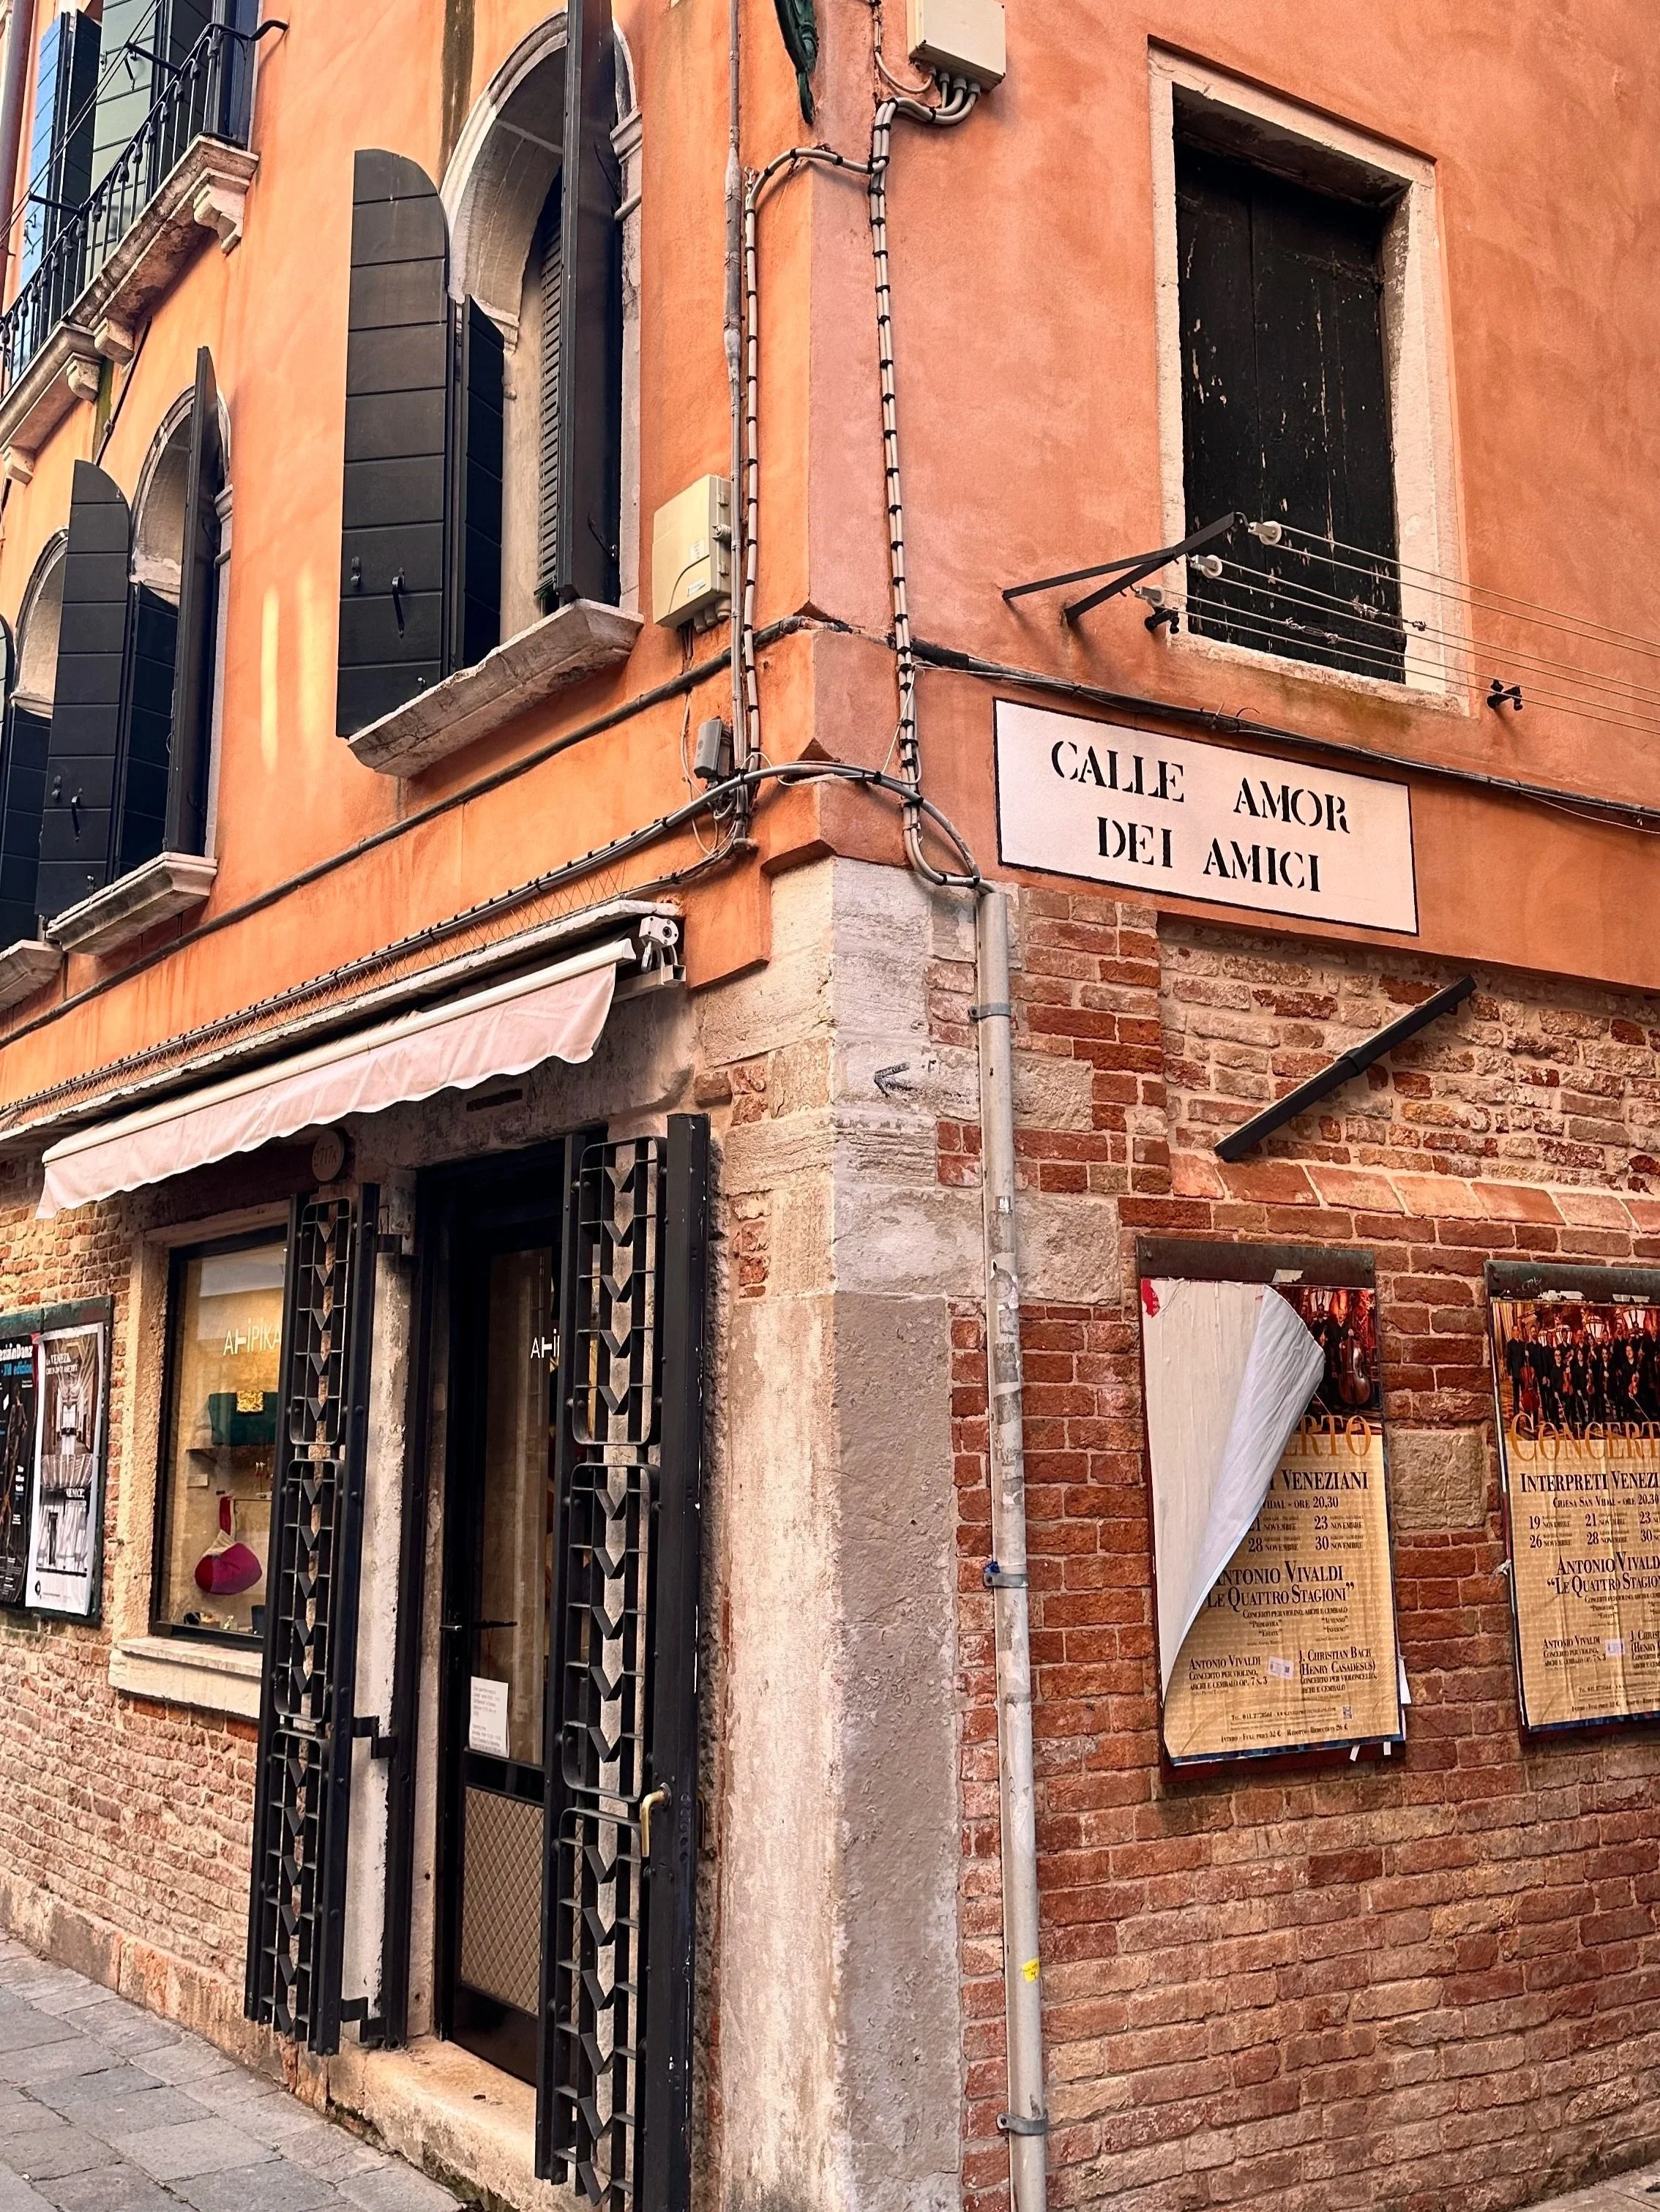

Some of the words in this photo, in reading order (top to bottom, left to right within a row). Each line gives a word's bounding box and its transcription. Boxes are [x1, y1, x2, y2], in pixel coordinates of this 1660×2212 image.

[1051, 740, 1185, 803] CALLE
[1233, 776, 1350, 834] AMOR
[1097, 816, 1173, 869] DEI
[1203, 837, 1321, 893] AMICI
[1510, 1413, 1660, 1462] CONCERT
[1281, 1469, 1369, 1491] VENEZIANI
[1519, 1472, 1609, 1493] INTERPRETI
[1611, 1469, 1659, 1490] VENEZI
[1552, 1496, 1577, 1508] CHIESA
[1579, 1496, 1593, 1507] SAN
[1314, 1515, 1328, 1530] 23
[1528, 1515, 1541, 1530] 19
[1585, 1512, 1597, 1527] 21
[1639, 1510, 1651, 1524] 23
[1315, 1535, 1329, 1551] 30
[1529, 1534, 1543, 1548] 26
[1586, 1531, 1599, 1545] 28
[1640, 1529, 1653, 1542] 30
[1248, 1537, 1263, 1553] 28
[1285, 1559, 1343, 1583] VIVALDI
[1557, 1555, 1616, 1575] ANTONIO
[1616, 1551, 1660, 1572] VIVALD
[1571, 1575, 1621, 1598] QUATTRO
[1227, 1586, 1290, 1613] QUATTRO
[1543, 1638, 1574, 1649] ANTONIO
[1574, 1635, 1601, 1646] VIVALDI
[1307, 1649, 1349, 1662] CHRISTIAN
[1350, 1646, 1372, 1659] BACH
[1602, 1653, 1607, 1662] 3
[1188, 1657, 1227, 1671] ANTONIO
[1228, 1654, 1261, 1667] VIVALDI
[1189, 1671, 1221, 1681] CONCERTO
[1221, 1671, 1233, 1679] PER
[1263, 1676, 1268, 1685] 3
